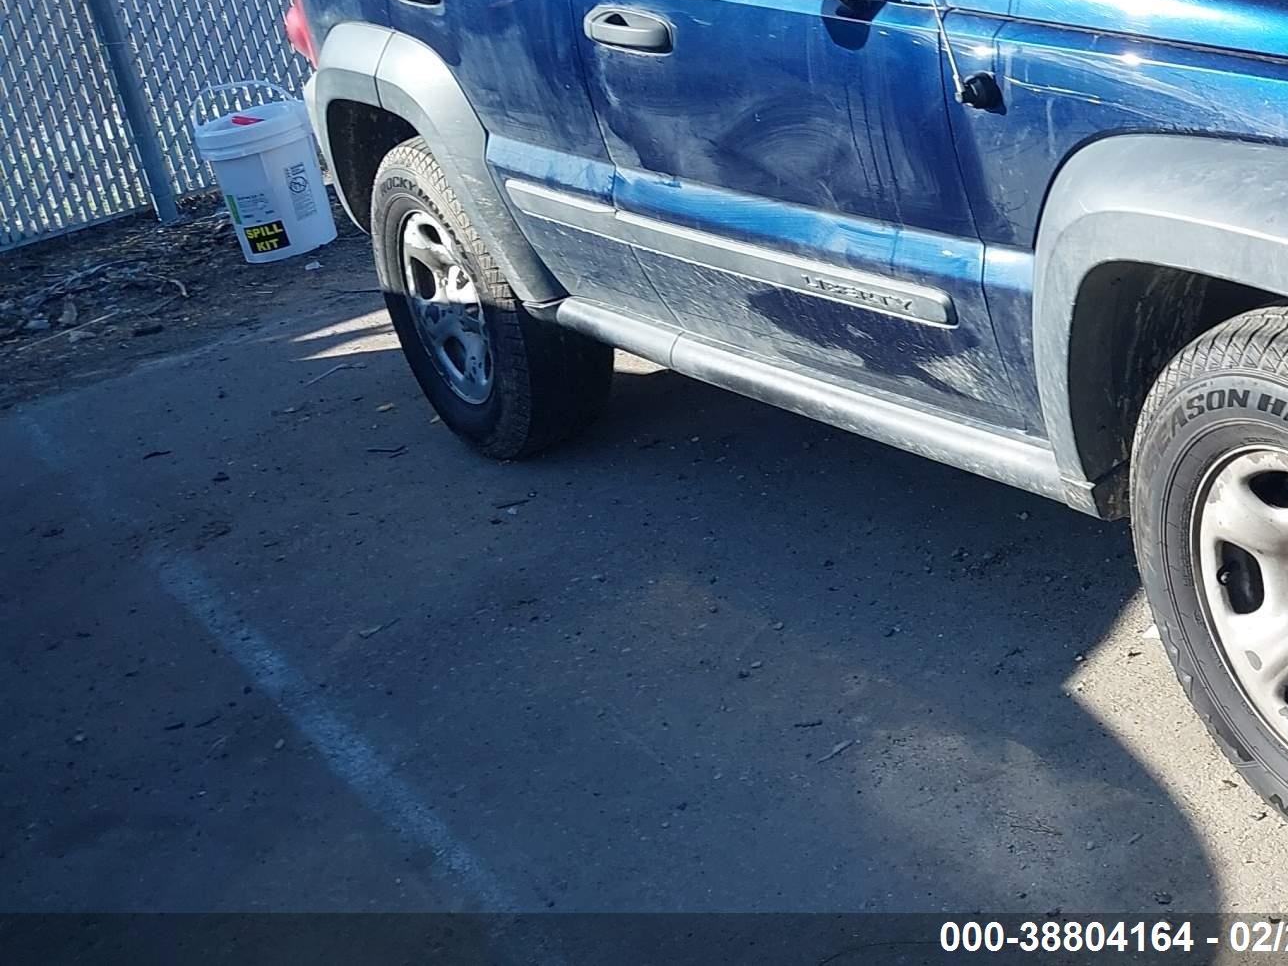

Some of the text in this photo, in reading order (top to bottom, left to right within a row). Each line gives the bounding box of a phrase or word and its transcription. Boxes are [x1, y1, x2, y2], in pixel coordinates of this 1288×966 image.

[246, 223, 284, 239] SPILL
[256, 238, 279, 252] KIT
[1147, 388, 1250, 466] EASON
